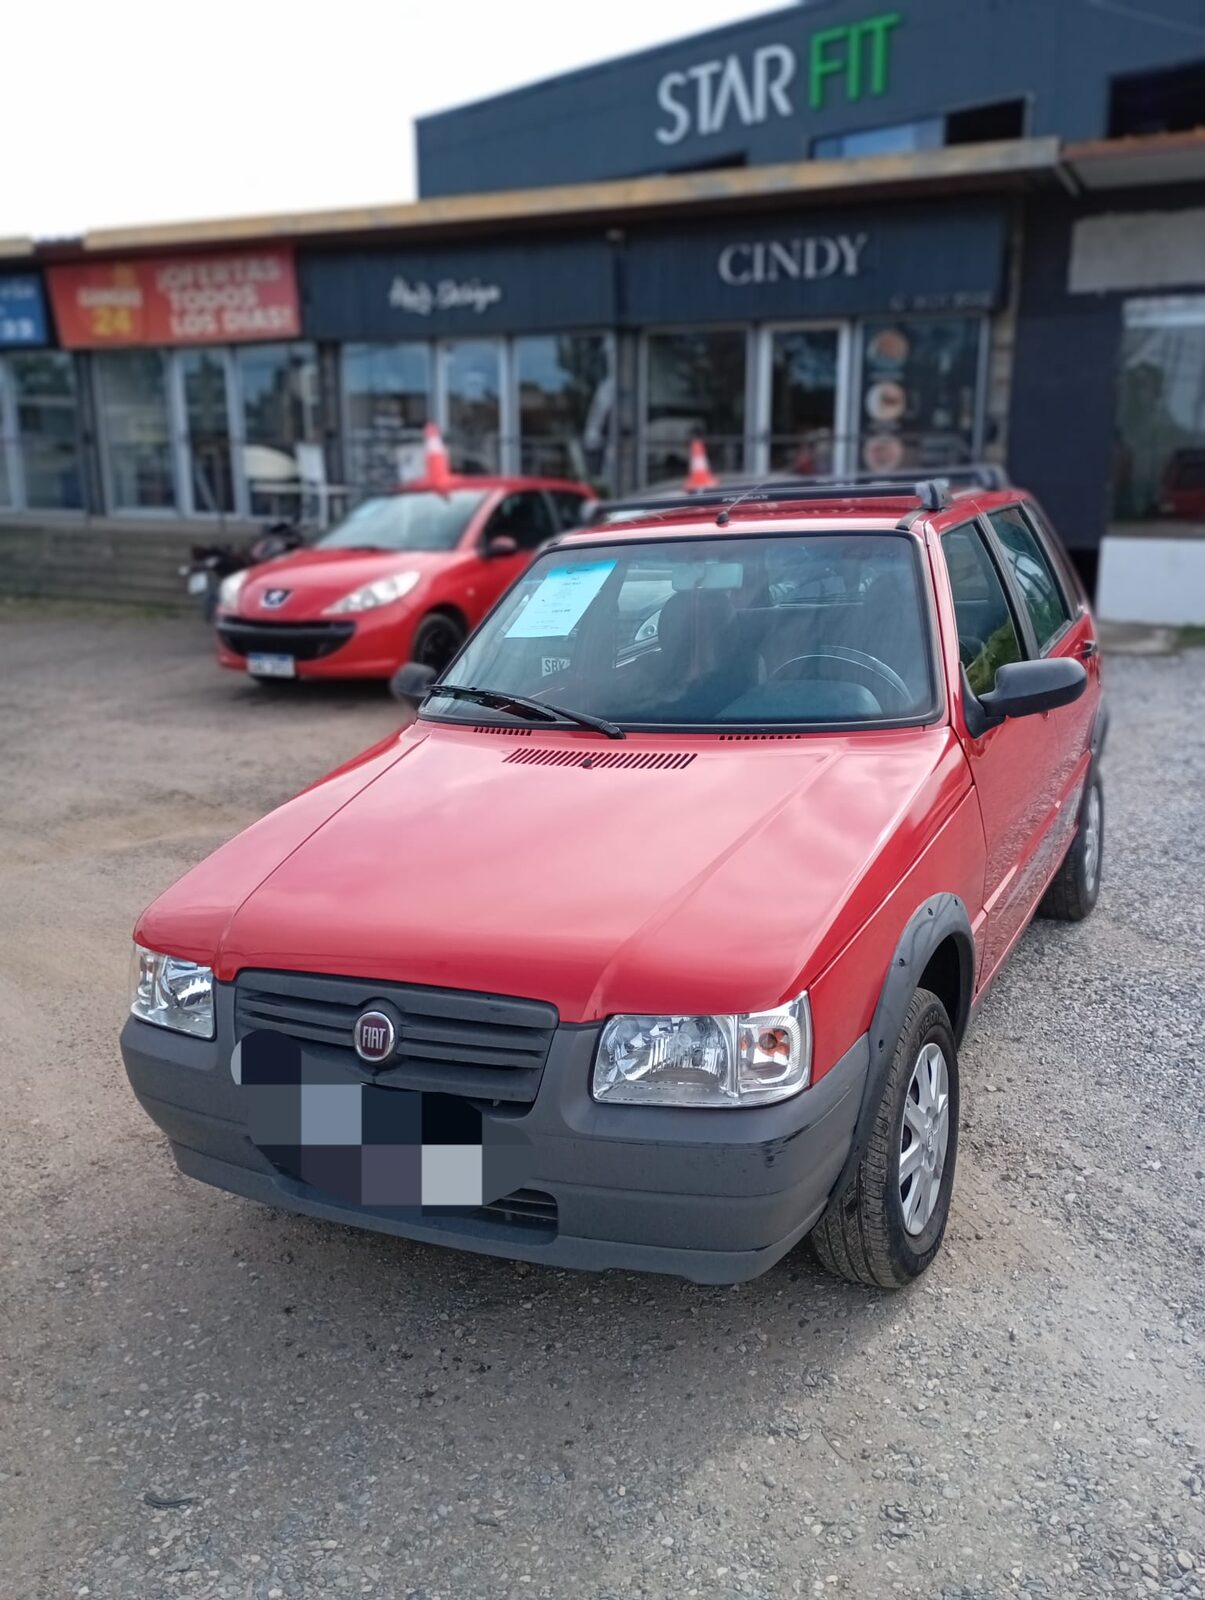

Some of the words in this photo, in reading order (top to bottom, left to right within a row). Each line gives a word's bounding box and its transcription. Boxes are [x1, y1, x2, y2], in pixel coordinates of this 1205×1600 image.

[656, 44, 796, 144] STAR
[808, 13, 902, 109] FIT
[717, 232, 867, 285] CINDY
[169, 284, 258, 312] TODOS
[169, 313, 218, 336] LOS
[362, 1025, 387, 1050] FIAT
